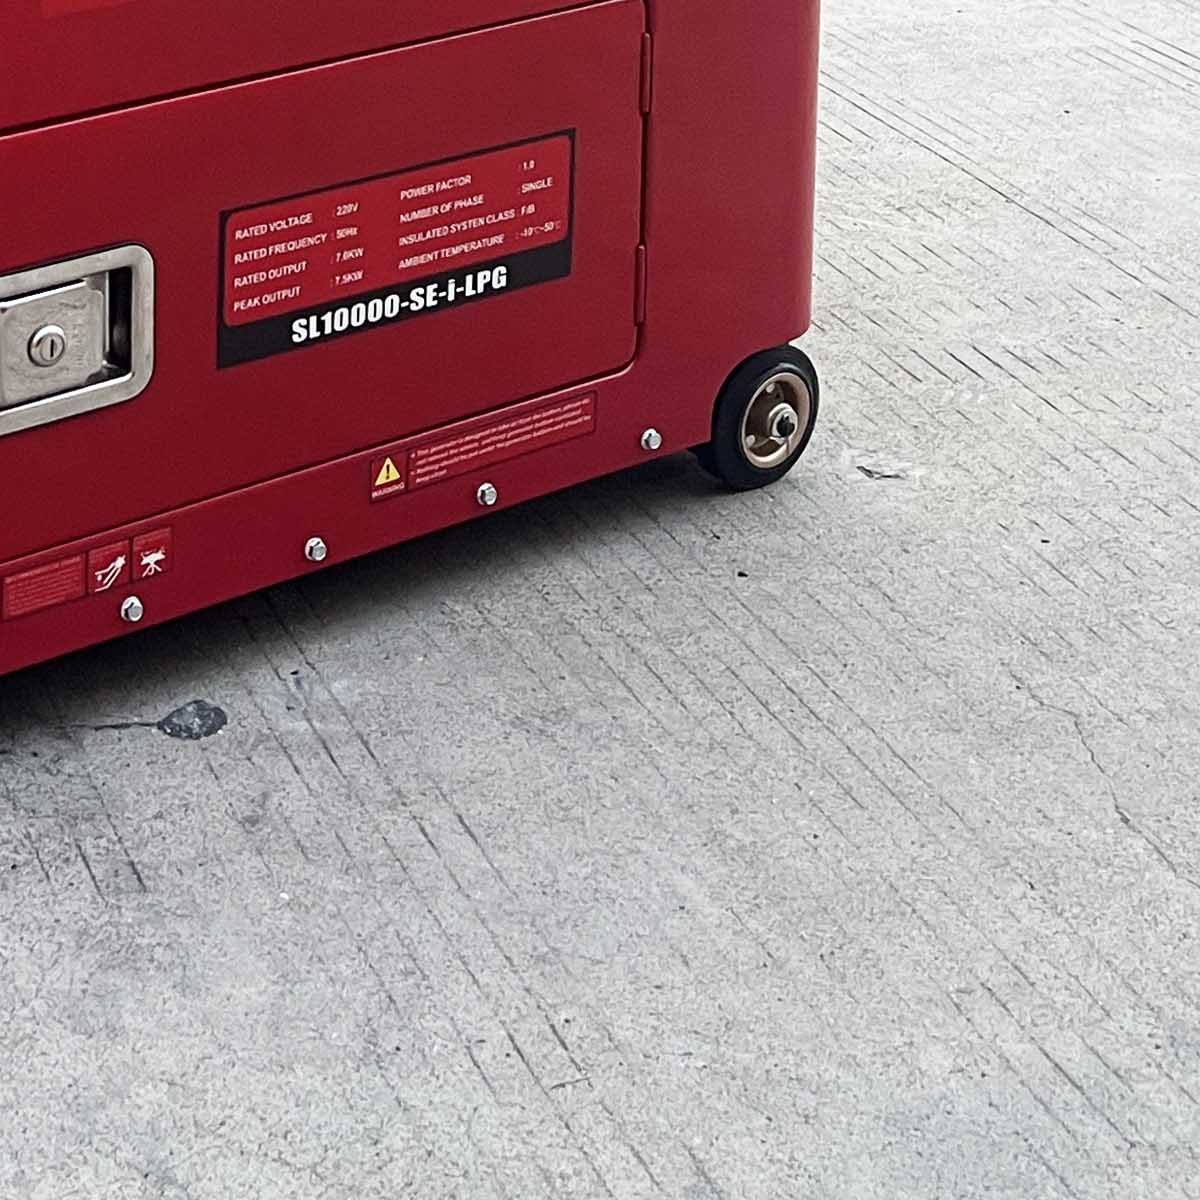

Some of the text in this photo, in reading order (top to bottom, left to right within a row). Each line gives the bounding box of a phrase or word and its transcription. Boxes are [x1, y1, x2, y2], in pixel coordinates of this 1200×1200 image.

[400, 183, 435, 201] POWER
[435, 174, 472, 193] FACTOR
[400, 176, 553, 224] NUMBER OF PHASE SINGLE
[234, 224, 268, 241] RATED
[269, 212, 314, 232] VOLTAGE
[399, 225, 450, 247] INSULATED
[486, 208, 516, 225] CLASS
[233, 247, 268, 265] RATED
[268, 232, 328, 257] FREQUENCY
[398, 251, 441, 270] AMBIENT
[440, 233, 505, 258] TEMPERATURE
[233, 271, 267, 289] RATED
[267, 260, 308, 280] OUTPUT
[233, 297, 262, 313] PEAK
[261, 285, 302, 305] OUTPUT
[291, 265, 508, 344] SL10000-SE-i-LPG
